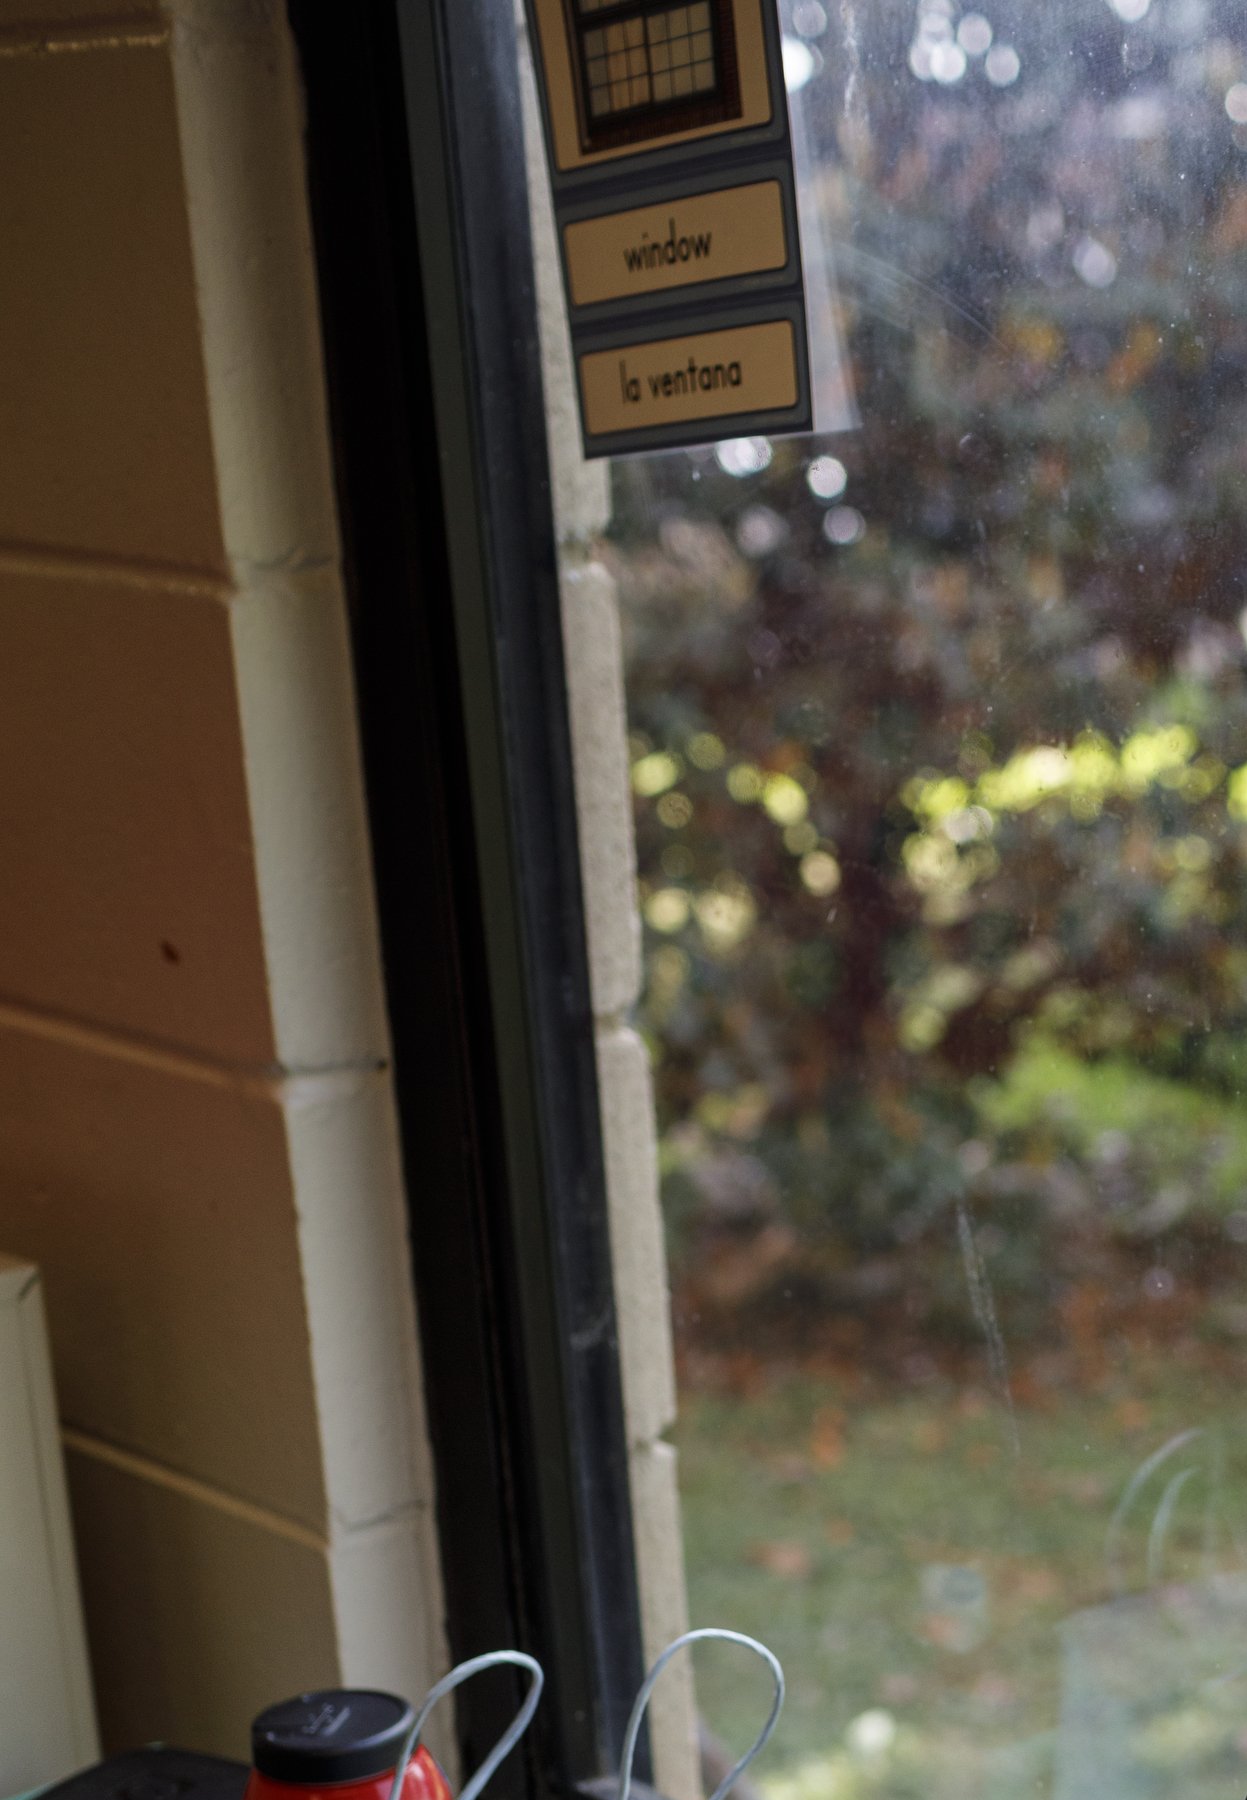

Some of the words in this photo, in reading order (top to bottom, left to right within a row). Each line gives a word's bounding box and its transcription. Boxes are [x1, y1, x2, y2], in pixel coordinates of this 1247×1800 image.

[624, 217, 712, 273] window
[619, 361, 640, 403] la
[647, 357, 742, 399] ventana
